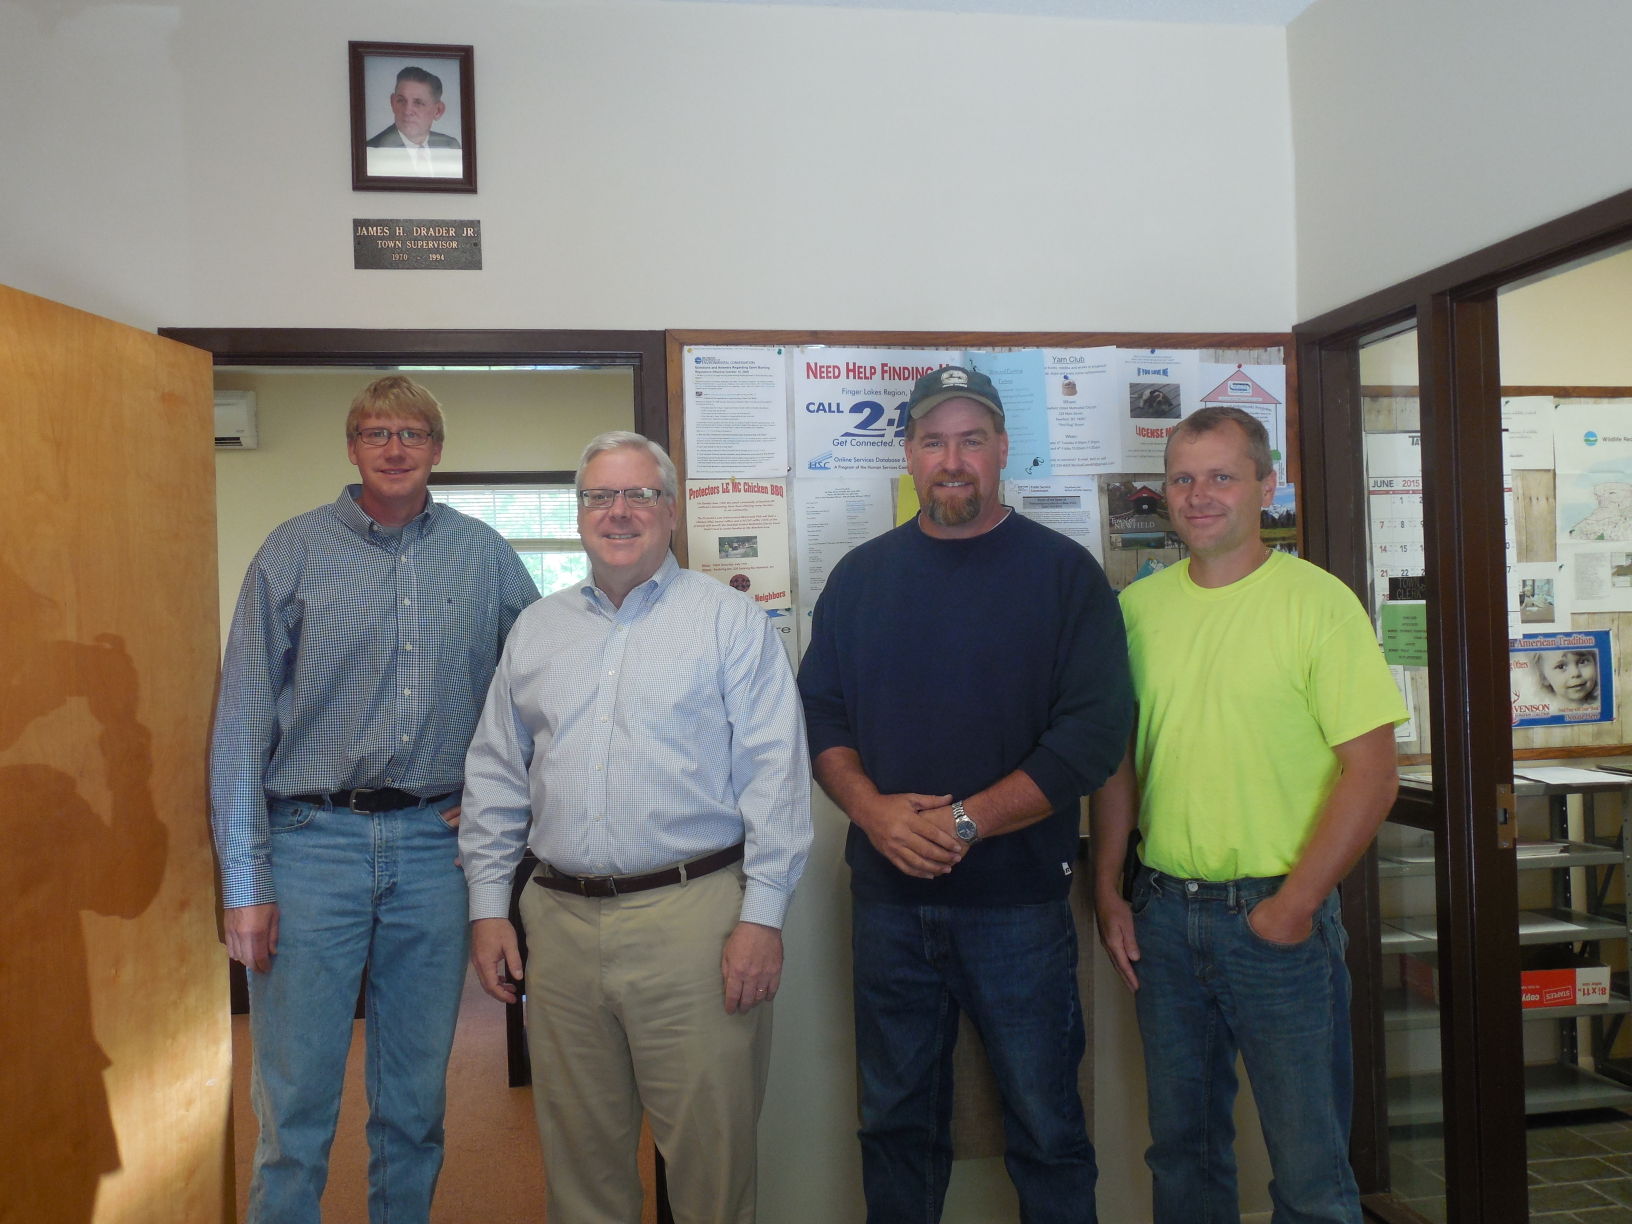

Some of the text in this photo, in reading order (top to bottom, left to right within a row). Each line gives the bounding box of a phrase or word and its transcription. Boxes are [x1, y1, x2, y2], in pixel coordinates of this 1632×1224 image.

[356, 226, 478, 237] JAMES H. DRADER JR.
[377, 240, 458, 249] TOWN SUPERVISOR
[392, 253, 408, 261] 1970
[429, 253, 445, 261] 1994
[806, 362, 841, 380] NEED
[845, 362, 877, 381] HELP
[842, 387, 862, 397] Finger
[864, 388, 881, 396] Lakes
[884, 388, 908, 398] Region,
[805, 401, 844, 414] CALL
[1135, 424, 1164, 438] LICENSE
[832, 439, 848, 447] Get
[850, 439, 895, 447] Connected.
[1372, 479, 1420, 488] JUNE 2015
[689, 481, 784, 500] Protectors LE MC Chicken BBQ
[1400, 496, 1404, 504] 1
[1114, 521, 1155, 529] NEWFIELD
[1379, 521, 1384, 529] 7
[1400, 520, 1405, 529] 8
[1380, 545, 1387, 553] 14
[1400, 545, 1408, 553] 15
[1380, 569, 1388, 577] 21
[1421, 568, 1426, 576] 2
[754, 591, 786, 602] Neighbors
[1519, 637, 1556, 648] American
[1559, 634, 1595, 646] Tradition
[1513, 703, 1550, 713] VENISON
[1545, 989, 1570, 1000] STAPLES
